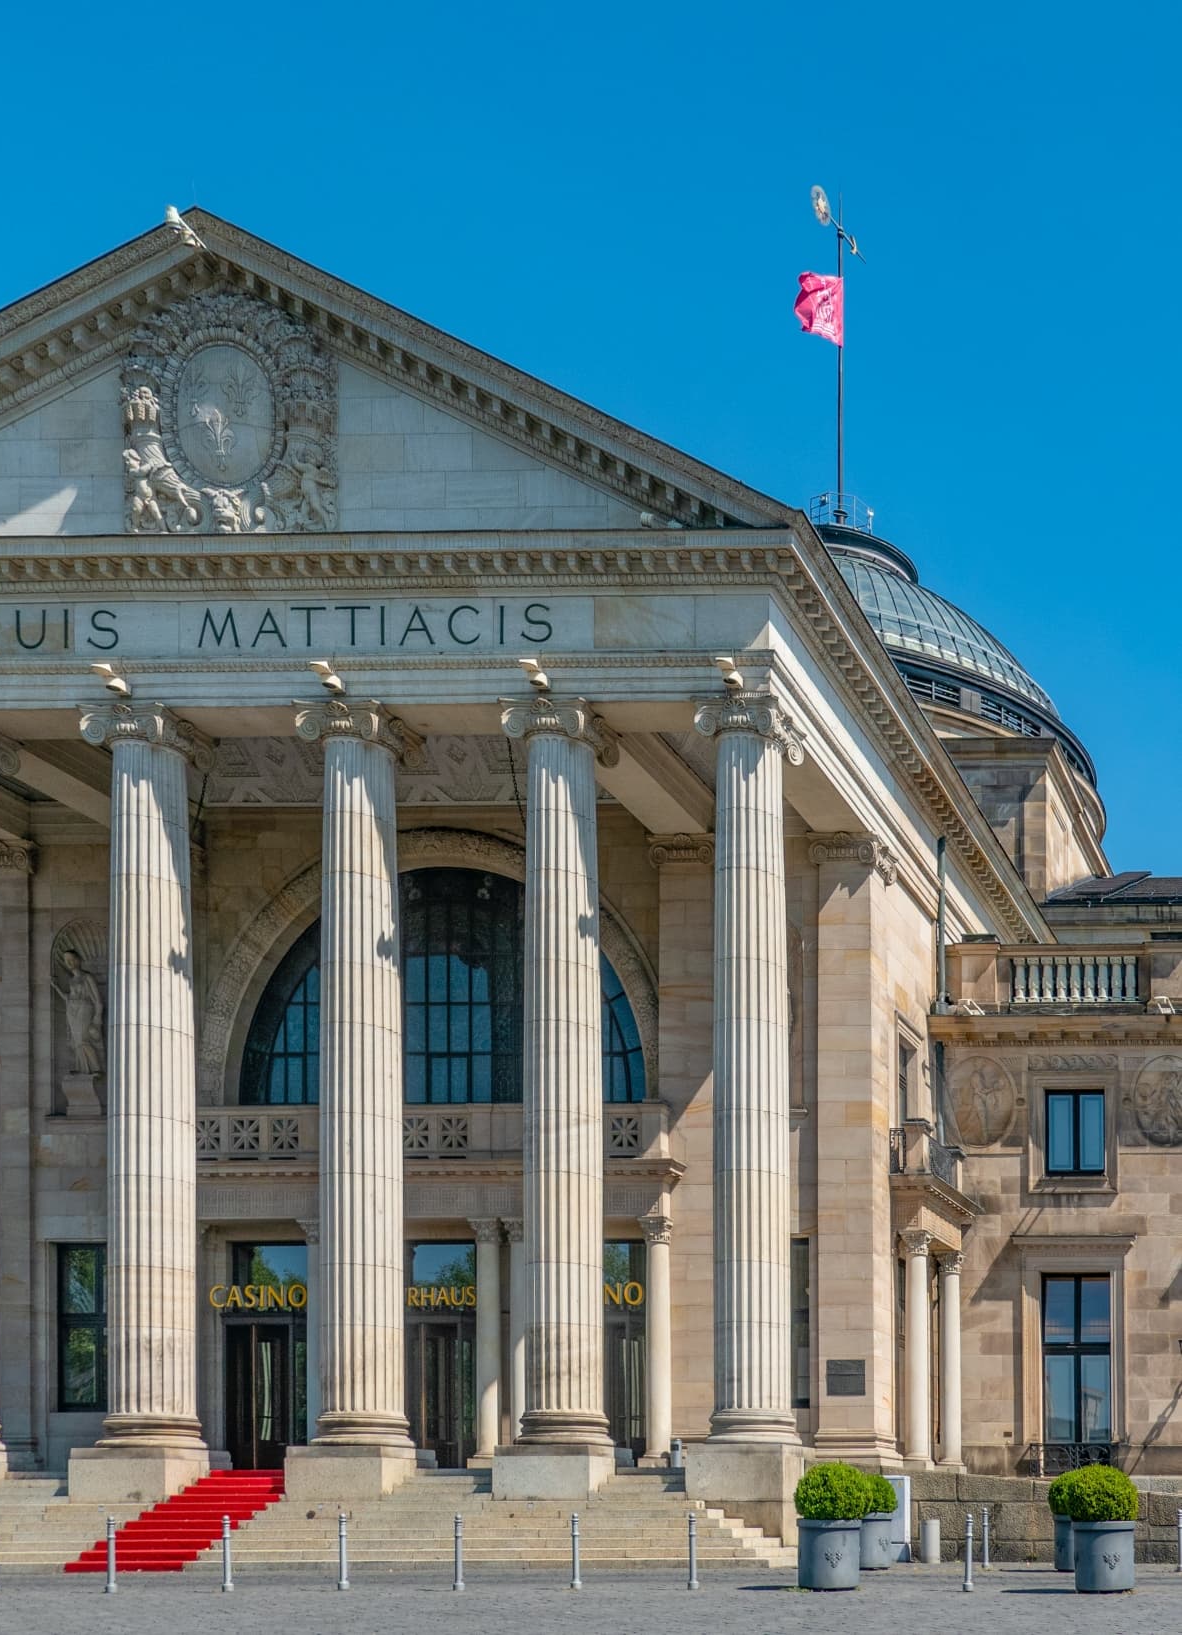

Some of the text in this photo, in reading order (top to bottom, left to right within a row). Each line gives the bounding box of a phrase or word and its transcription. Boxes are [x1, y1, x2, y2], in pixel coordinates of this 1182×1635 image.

[198, 603, 553, 648] MATTIACIS
[209, 1284, 307, 1308] CASINO
[405, 1286, 477, 1306] RHAUS
[603, 1281, 643, 1306] NO
